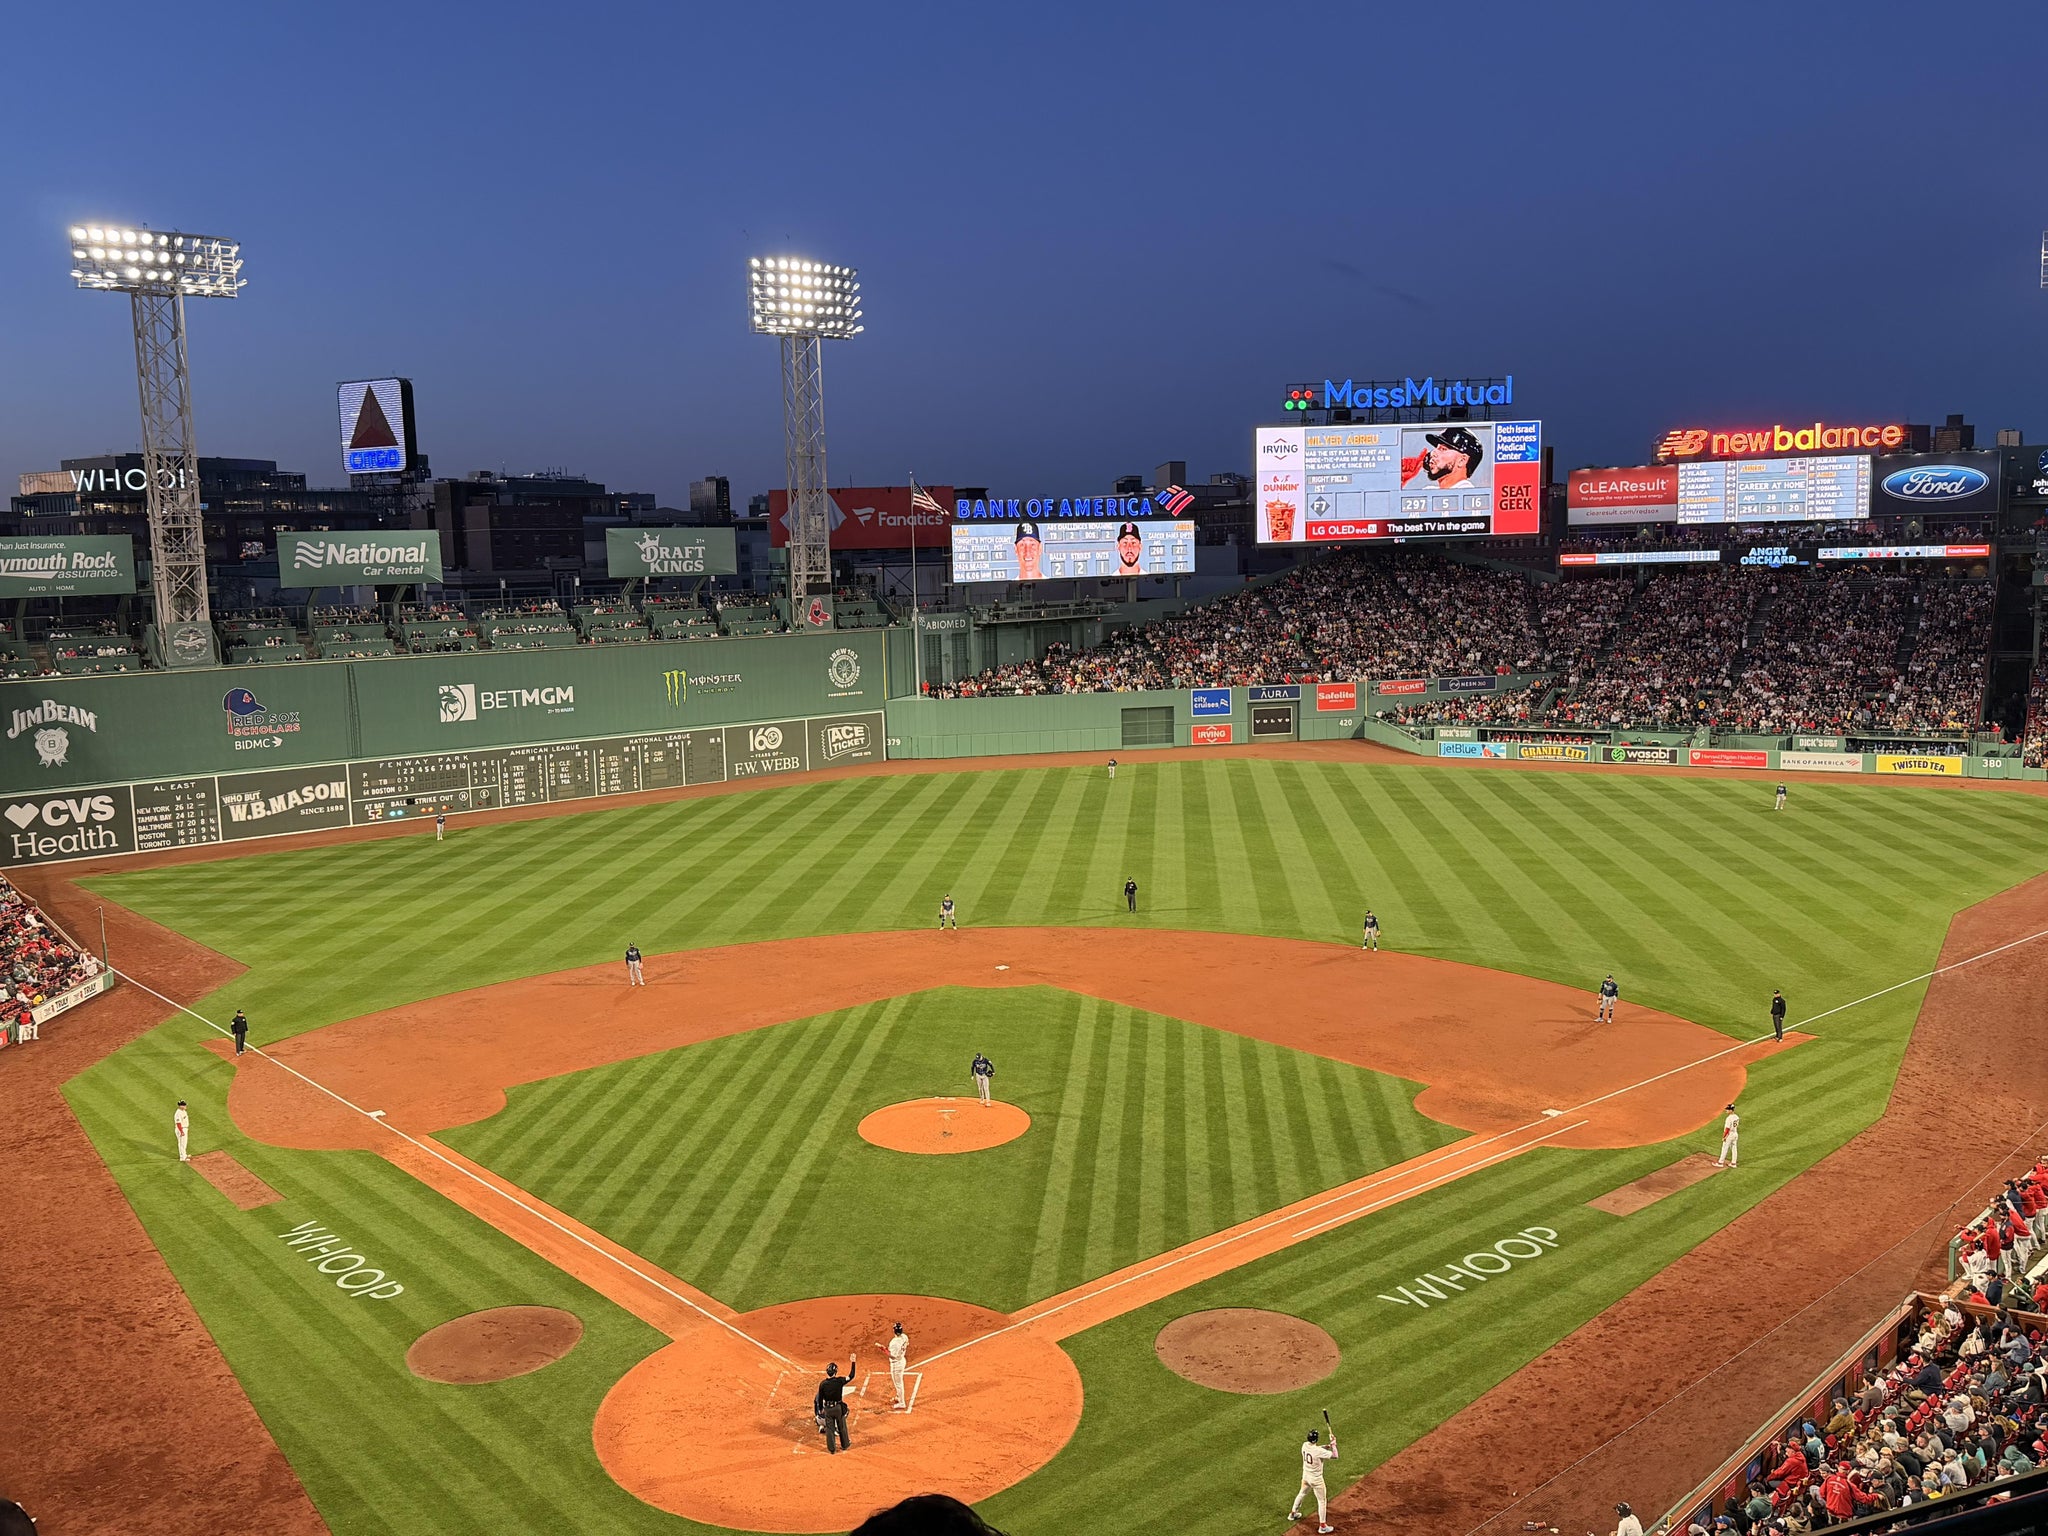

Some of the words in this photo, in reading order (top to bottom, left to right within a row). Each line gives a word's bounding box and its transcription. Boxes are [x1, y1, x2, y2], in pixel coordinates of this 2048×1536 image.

[1324, 375, 1513, 409] MassMutual
[1497, 425, 1515, 434] Beth
[1515, 424, 1536, 433] Israel
[1345, 434, 1379, 445] ABREU
[1497, 434, 1537, 443] Deaconess
[1263, 444, 1298, 454] IRVING
[1497, 443, 1526, 452] Medical
[350, 449, 400, 470] CITGO
[1497, 451, 1522, 461] Center
[1579, 478, 1667, 494] CLEAResult
[1739, 482, 1769, 490] CAREER
[1784, 481, 1806, 489] HOME
[1902, 471, 1967, 495] Ford
[1501, 485, 1532, 497] SEAT
[957, 499, 1020, 519] BANK
[1026, 498, 1054, 518] OF
[1059, 497, 1153, 517] AMERICA
[1313, 501, 1327, 512] F7
[1402, 500, 1426, 510] .297
[1442, 498, 1449, 509] 5
[1471, 497, 1482, 508] 16
[1499, 498, 1533, 511] GEEK
[1788, 504, 1800, 512] 20
[878, 511, 944, 527] Fanatics
[1312, 526, 1326, 535] LG
[1328, 525, 1355, 535] OLED
[1387, 523, 1403, 533] The
[1404, 522, 1423, 532] best
[1424, 522, 1437, 531] TV
[1437, 521, 1445, 531] in
[1445, 521, 1461, 530] the
[1461, 522, 1486, 532] game
[14, 542, 29, 550] Just
[1749, 547, 1788, 557] ANGRY
[71, 551, 117, 569] Rock
[641, 546, 706, 563] DRAFT
[1740, 555, 1797, 565] ORCHARD
[362, 566, 384, 576] Car
[386, 565, 424, 575] Rental
[650, 560, 705, 573] KINGS
[1054, 563, 1061, 576] 2
[1077, 562, 1084, 575] 2
[57, 569, 118, 579] assurance
[925, 619, 966, 630] ABIOMED
[829, 648, 847, 662] IBEW
[689, 674, 743, 686] MONSTER
[697, 686, 736, 694] ENERGY
[1397, 682, 1425, 693] TICKET
[480, 685, 574, 710] BETMGM
[1194, 695, 1207, 703] city
[1318, 692, 1355, 700] Safelite
[1194, 701, 1219, 709] cruises
[233, 715, 265, 726] RED
[269, 711, 300, 723] SOX
[233, 723, 301, 737] SCHOLARS
[831, 725, 865, 742] ACE
[1197, 729, 1226, 739] IRVING
[1439, 729, 1459, 738] DICK'S
[234, 738, 271, 751] BIDMC
[629, 737, 662, 745] NATIONAL
[665, 733, 691, 741] LEAGUE
[749, 726, 783, 752] 160
[832, 737, 865, 752] TICKET
[886, 738, 901, 746] 379
[1799, 738, 1824, 748] DICK'S
[509, 747, 548, 756] AMERICAN
[551, 744, 580, 752] LEAGUE
[1442, 743, 1477, 755] jetBlue
[1521, 746, 1563, 757] GRANITE
[1565, 746, 1587, 760] CITY
[1626, 748, 1670, 760] wasabi
[379, 758, 429, 769] FENWAY
[438, 754, 469, 764] PARK
[734, 761, 758, 776] F.W.
[760, 756, 800, 772] WEBB
[1892, 760, 1928, 771] TWISTED
[1929, 762, 1945, 773] TEA
[1982, 759, 2002, 768] 380
[170, 782, 196, 791] EAST
[371, 786, 396, 796] BOSTON
[195, 792, 206, 800] GB
[223, 793, 241, 804] WHO
[244, 791, 261, 801] BUT
[390, 799, 407, 808] BALL
[414, 796, 437, 805] STRIKE
[440, 794, 454, 802] OUT
[42, 795, 115, 827] CVS
[136, 807, 151, 815] NEW
[152, 805, 171, 813] YORK
[186, 802, 194, 810] 12
[300, 807, 325, 816] SINCE
[326, 804, 344, 813] 1898
[368, 808, 383, 820] 52
[137, 816, 159, 824] TAMPA
[159, 813, 172, 821] BAY
[137, 822, 173, 832] BALTIMORE
[11, 824, 119, 859] Health
[138, 832, 166, 841] BOSTON
[139, 839, 172, 849] TORONTO
[83, 982, 97, 995] TRULY
[55, 996, 69, 1009] TRULY
[277, 1220, 405, 1300] WHOOP
[1376, 1226, 1560, 1309] WHOOP
[1302, 1450, 1313, 1465] 10
